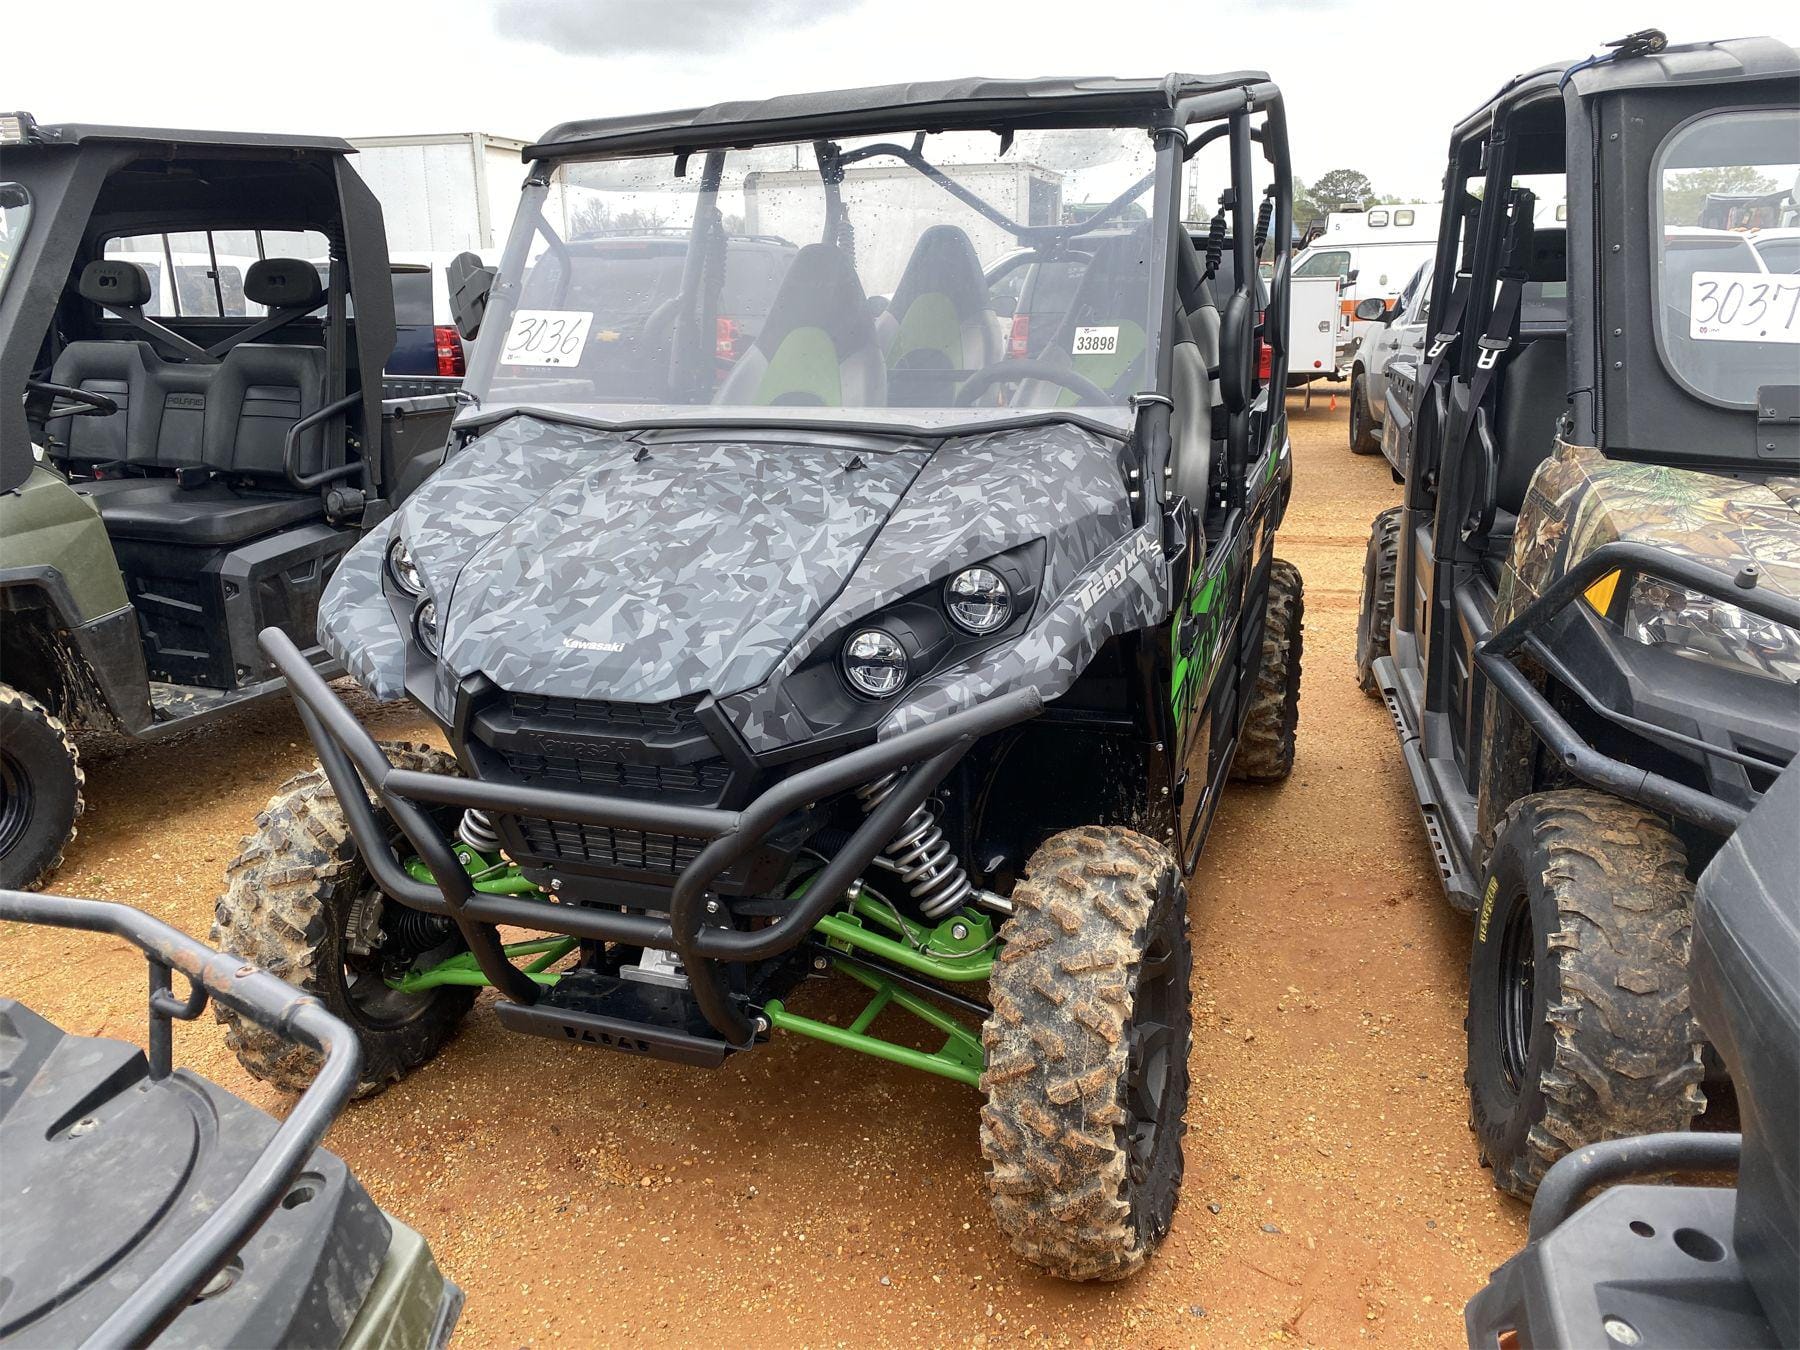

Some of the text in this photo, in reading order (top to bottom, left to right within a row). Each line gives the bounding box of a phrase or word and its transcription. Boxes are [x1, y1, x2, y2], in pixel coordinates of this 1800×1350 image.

[1696, 281, 1800, 329] 3037
[507, 318, 582, 354] 3036
[1077, 336, 1115, 351] 33898
[563, 638, 626, 652] Kawasaki
